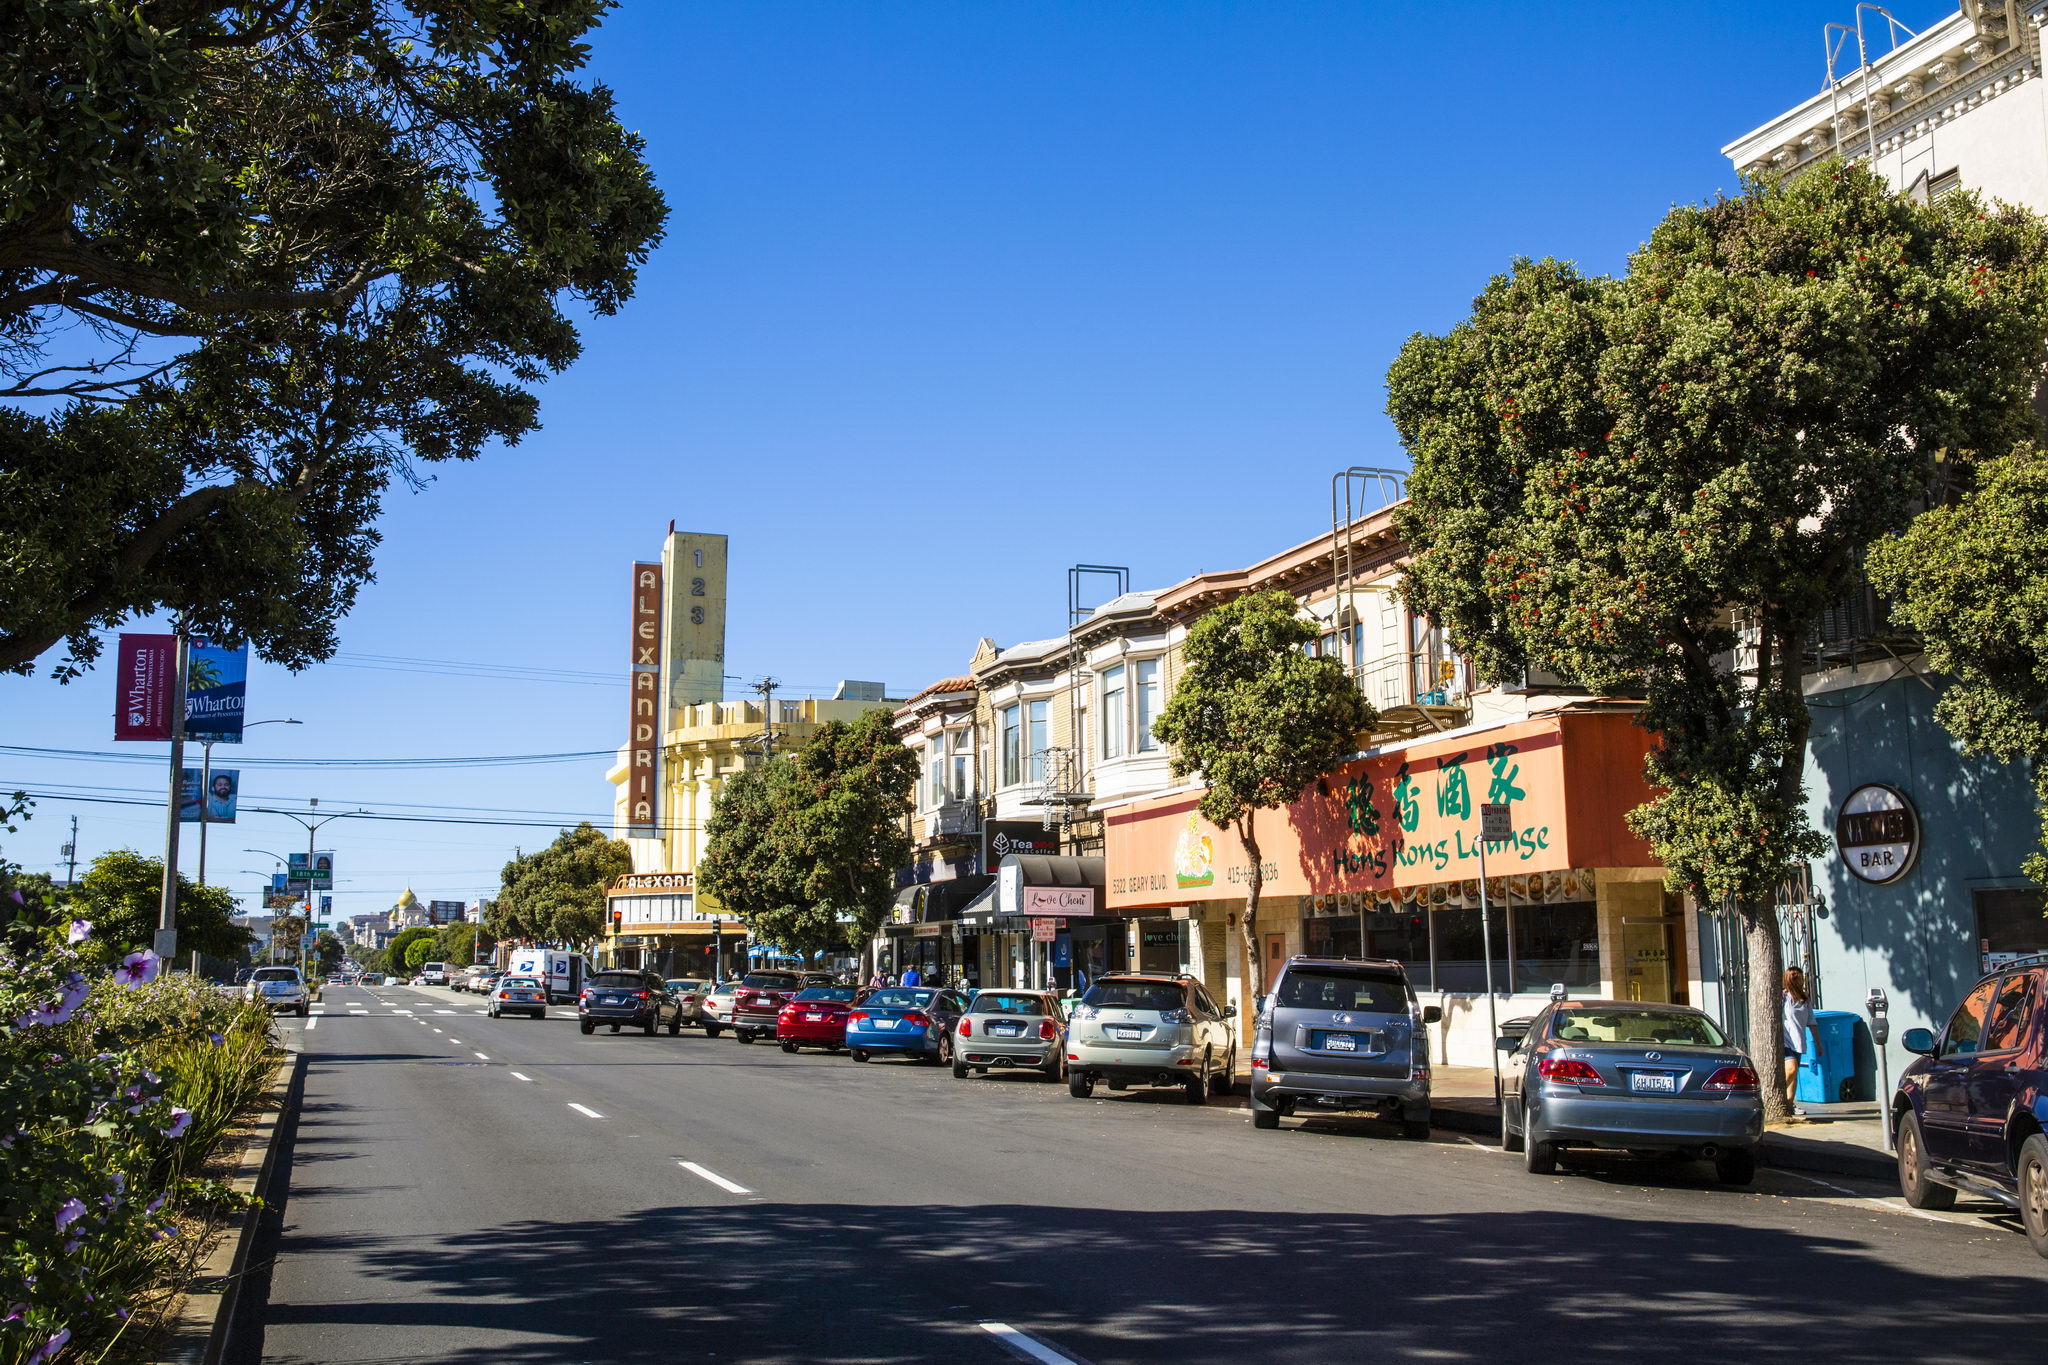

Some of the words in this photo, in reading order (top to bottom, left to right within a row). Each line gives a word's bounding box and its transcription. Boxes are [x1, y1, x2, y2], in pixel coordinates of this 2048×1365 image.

[128, 648, 147, 711] Wharton
[635, 570, 656, 821] ALEXANDRIA
[1333, 847, 1387, 879] Hong
[1391, 838, 1449, 871] Kong
[1861, 850, 1893, 867] BAR
[1113, 879, 1126, 894] 5322
[1129, 875, 1149, 892] GEARY
[1150, 873, 1168, 890] BLVD.
[1635, 1077, 1673, 1090] 6HJT543
